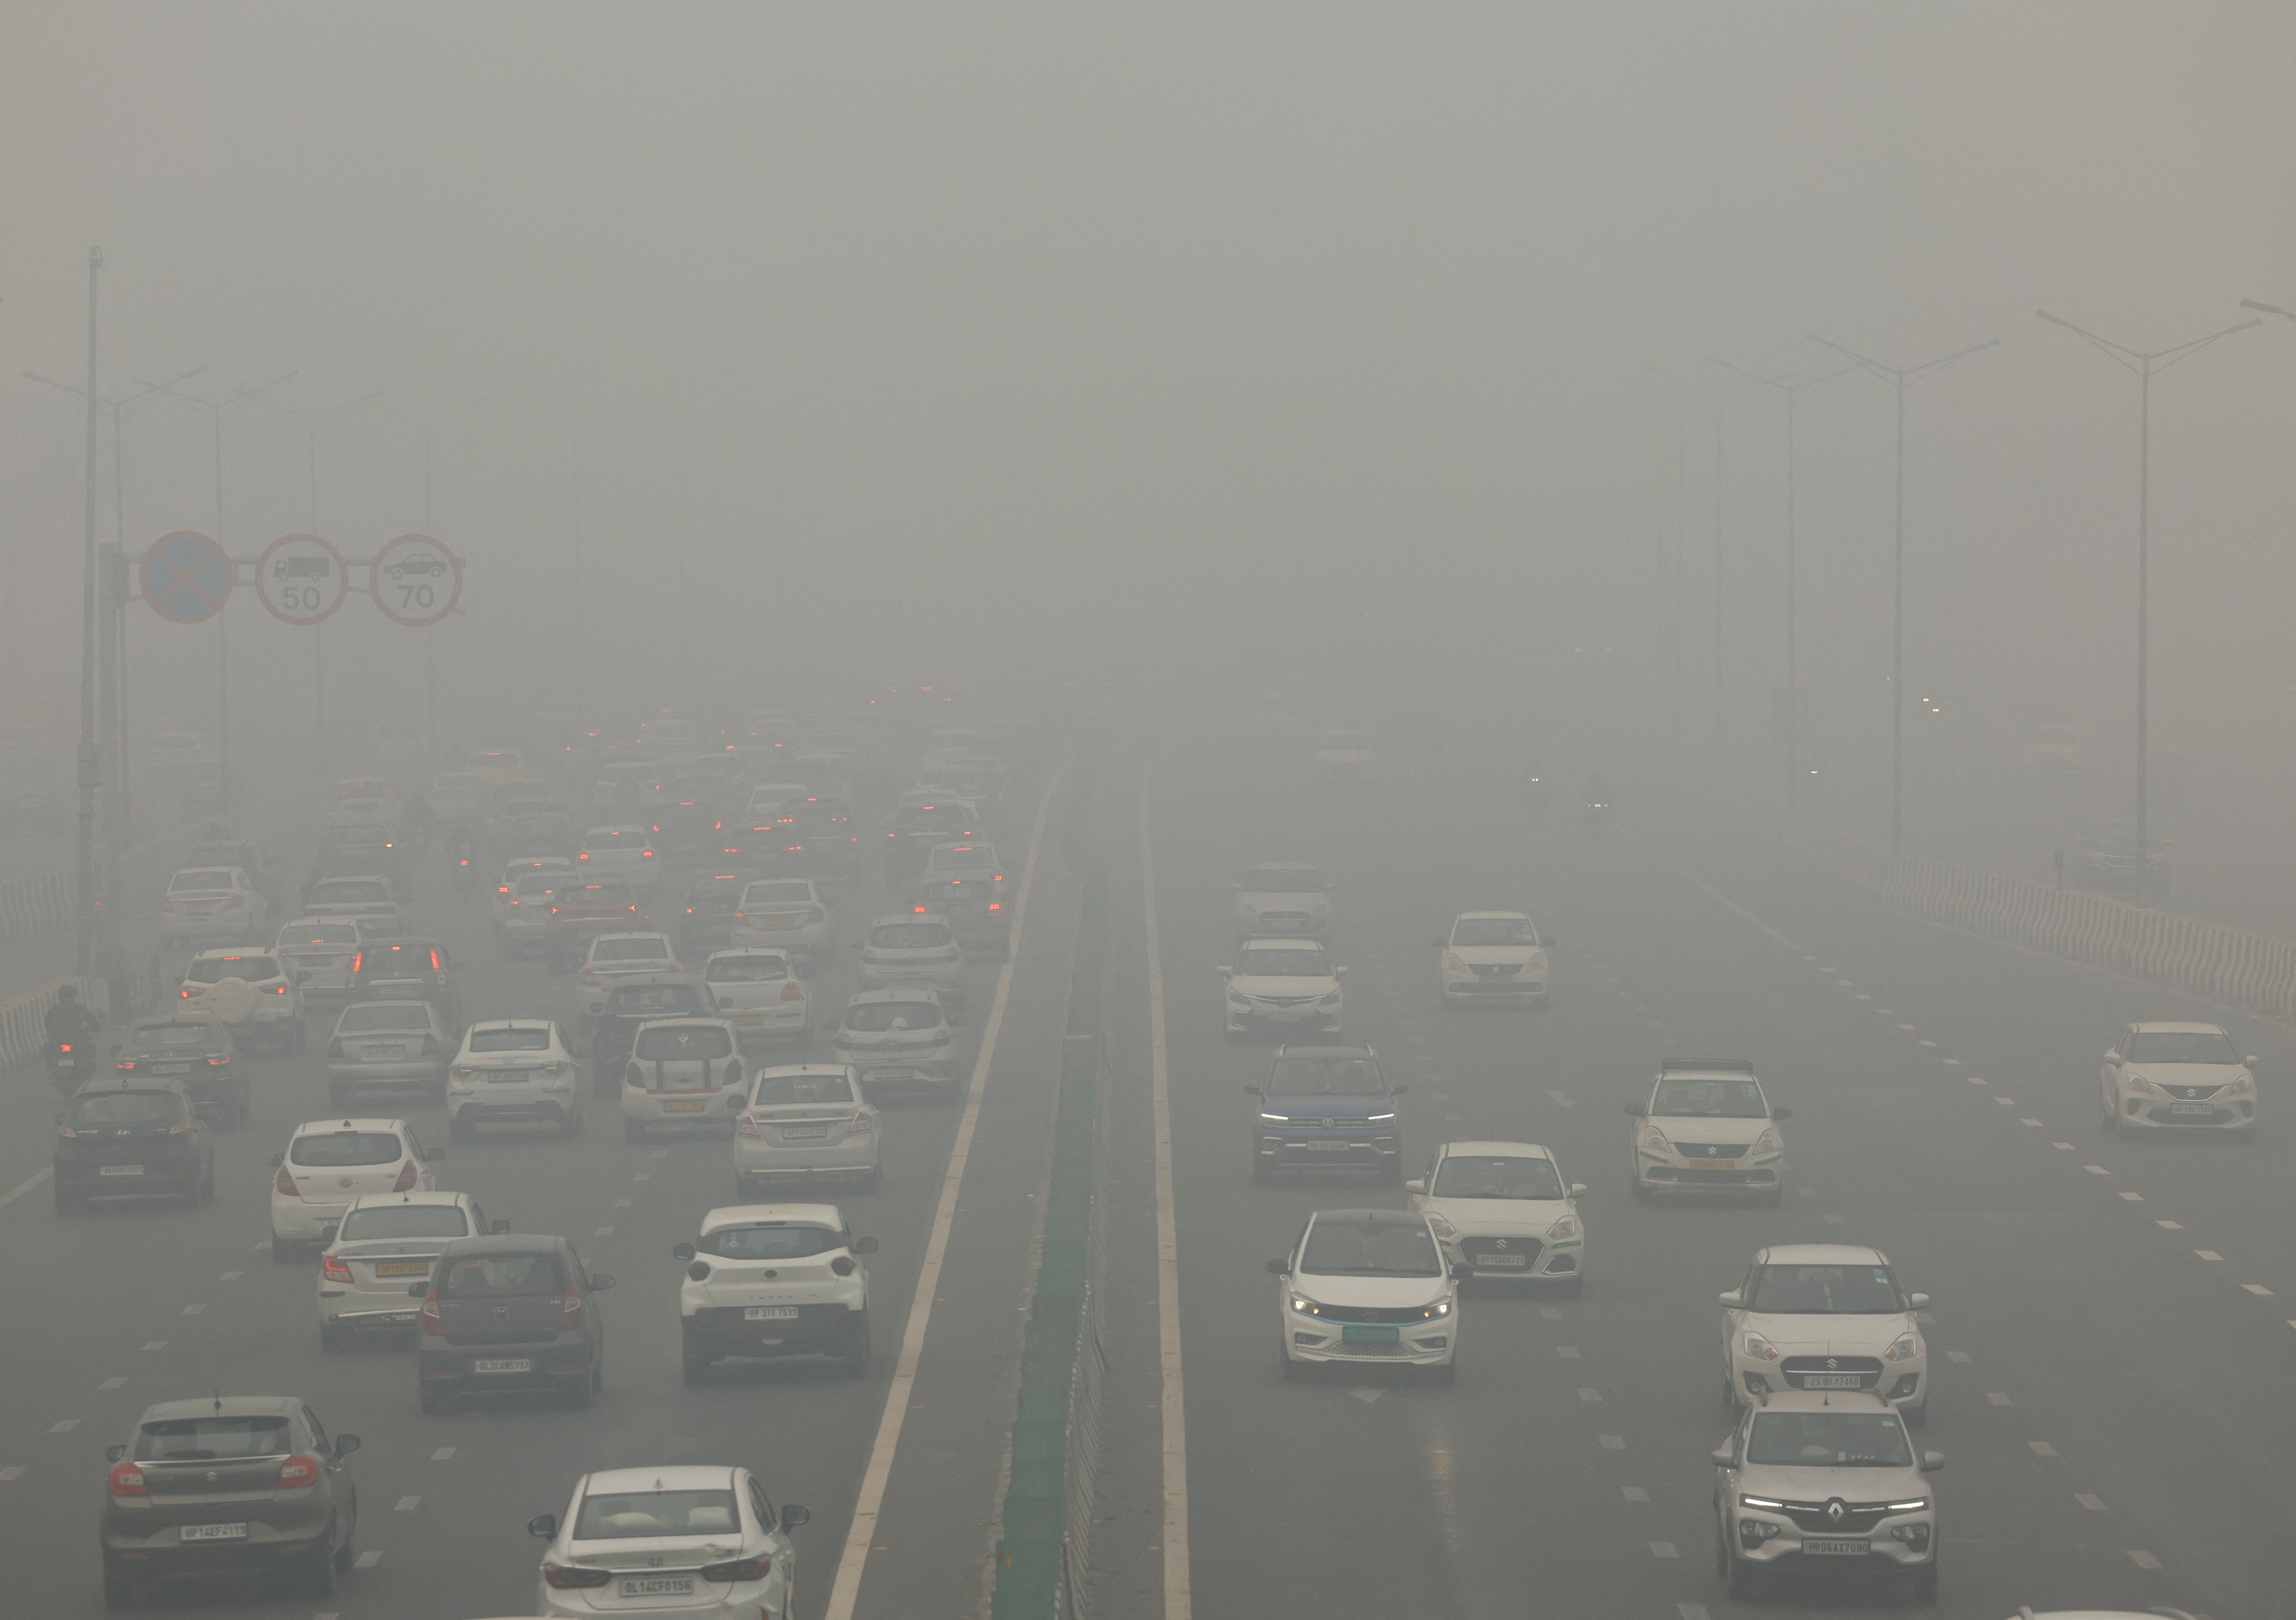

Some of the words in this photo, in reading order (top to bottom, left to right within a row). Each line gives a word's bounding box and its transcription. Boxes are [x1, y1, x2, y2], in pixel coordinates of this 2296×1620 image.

[283, 587, 320, 610] 50
[398, 585, 434, 608] 70
[1809, 1543, 1868, 1552] HR06AX7080
[626, 1579, 691, 1593] DL14CF0156
